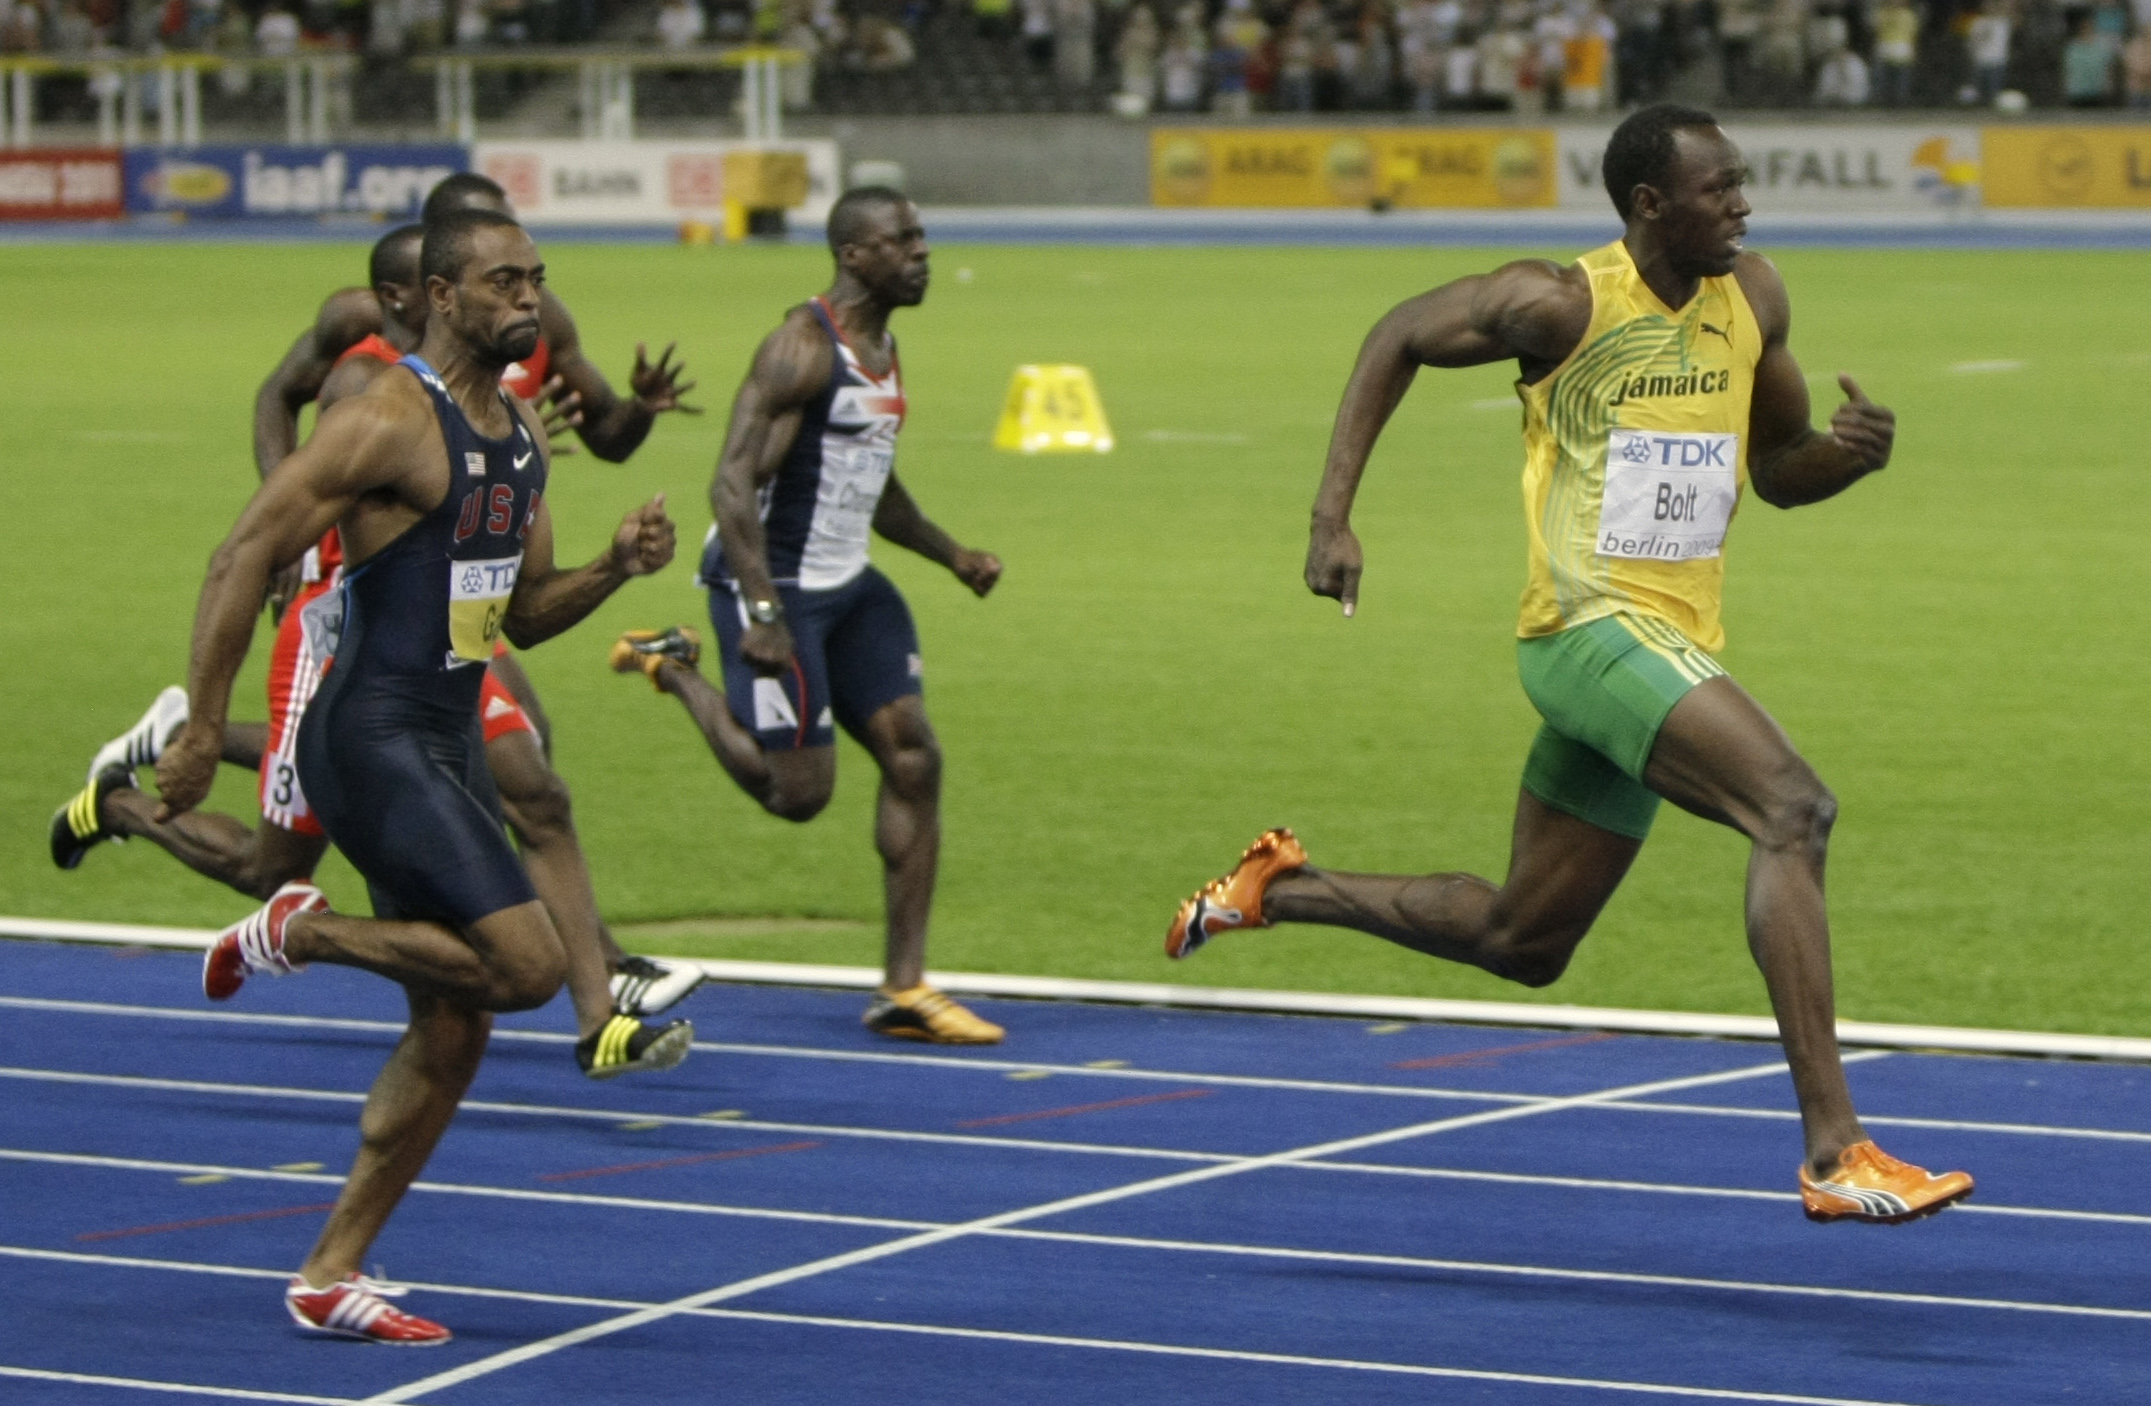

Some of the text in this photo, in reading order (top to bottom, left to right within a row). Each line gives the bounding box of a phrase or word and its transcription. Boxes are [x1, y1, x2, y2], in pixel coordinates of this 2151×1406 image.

[1608, 366, 1730, 407] jamaica
[1652, 437, 1727, 467] TDK
[1654, 482, 1698, 522] Bolt
[1602, 531, 1680, 558] berlin
[274, 763, 294, 806] 3
